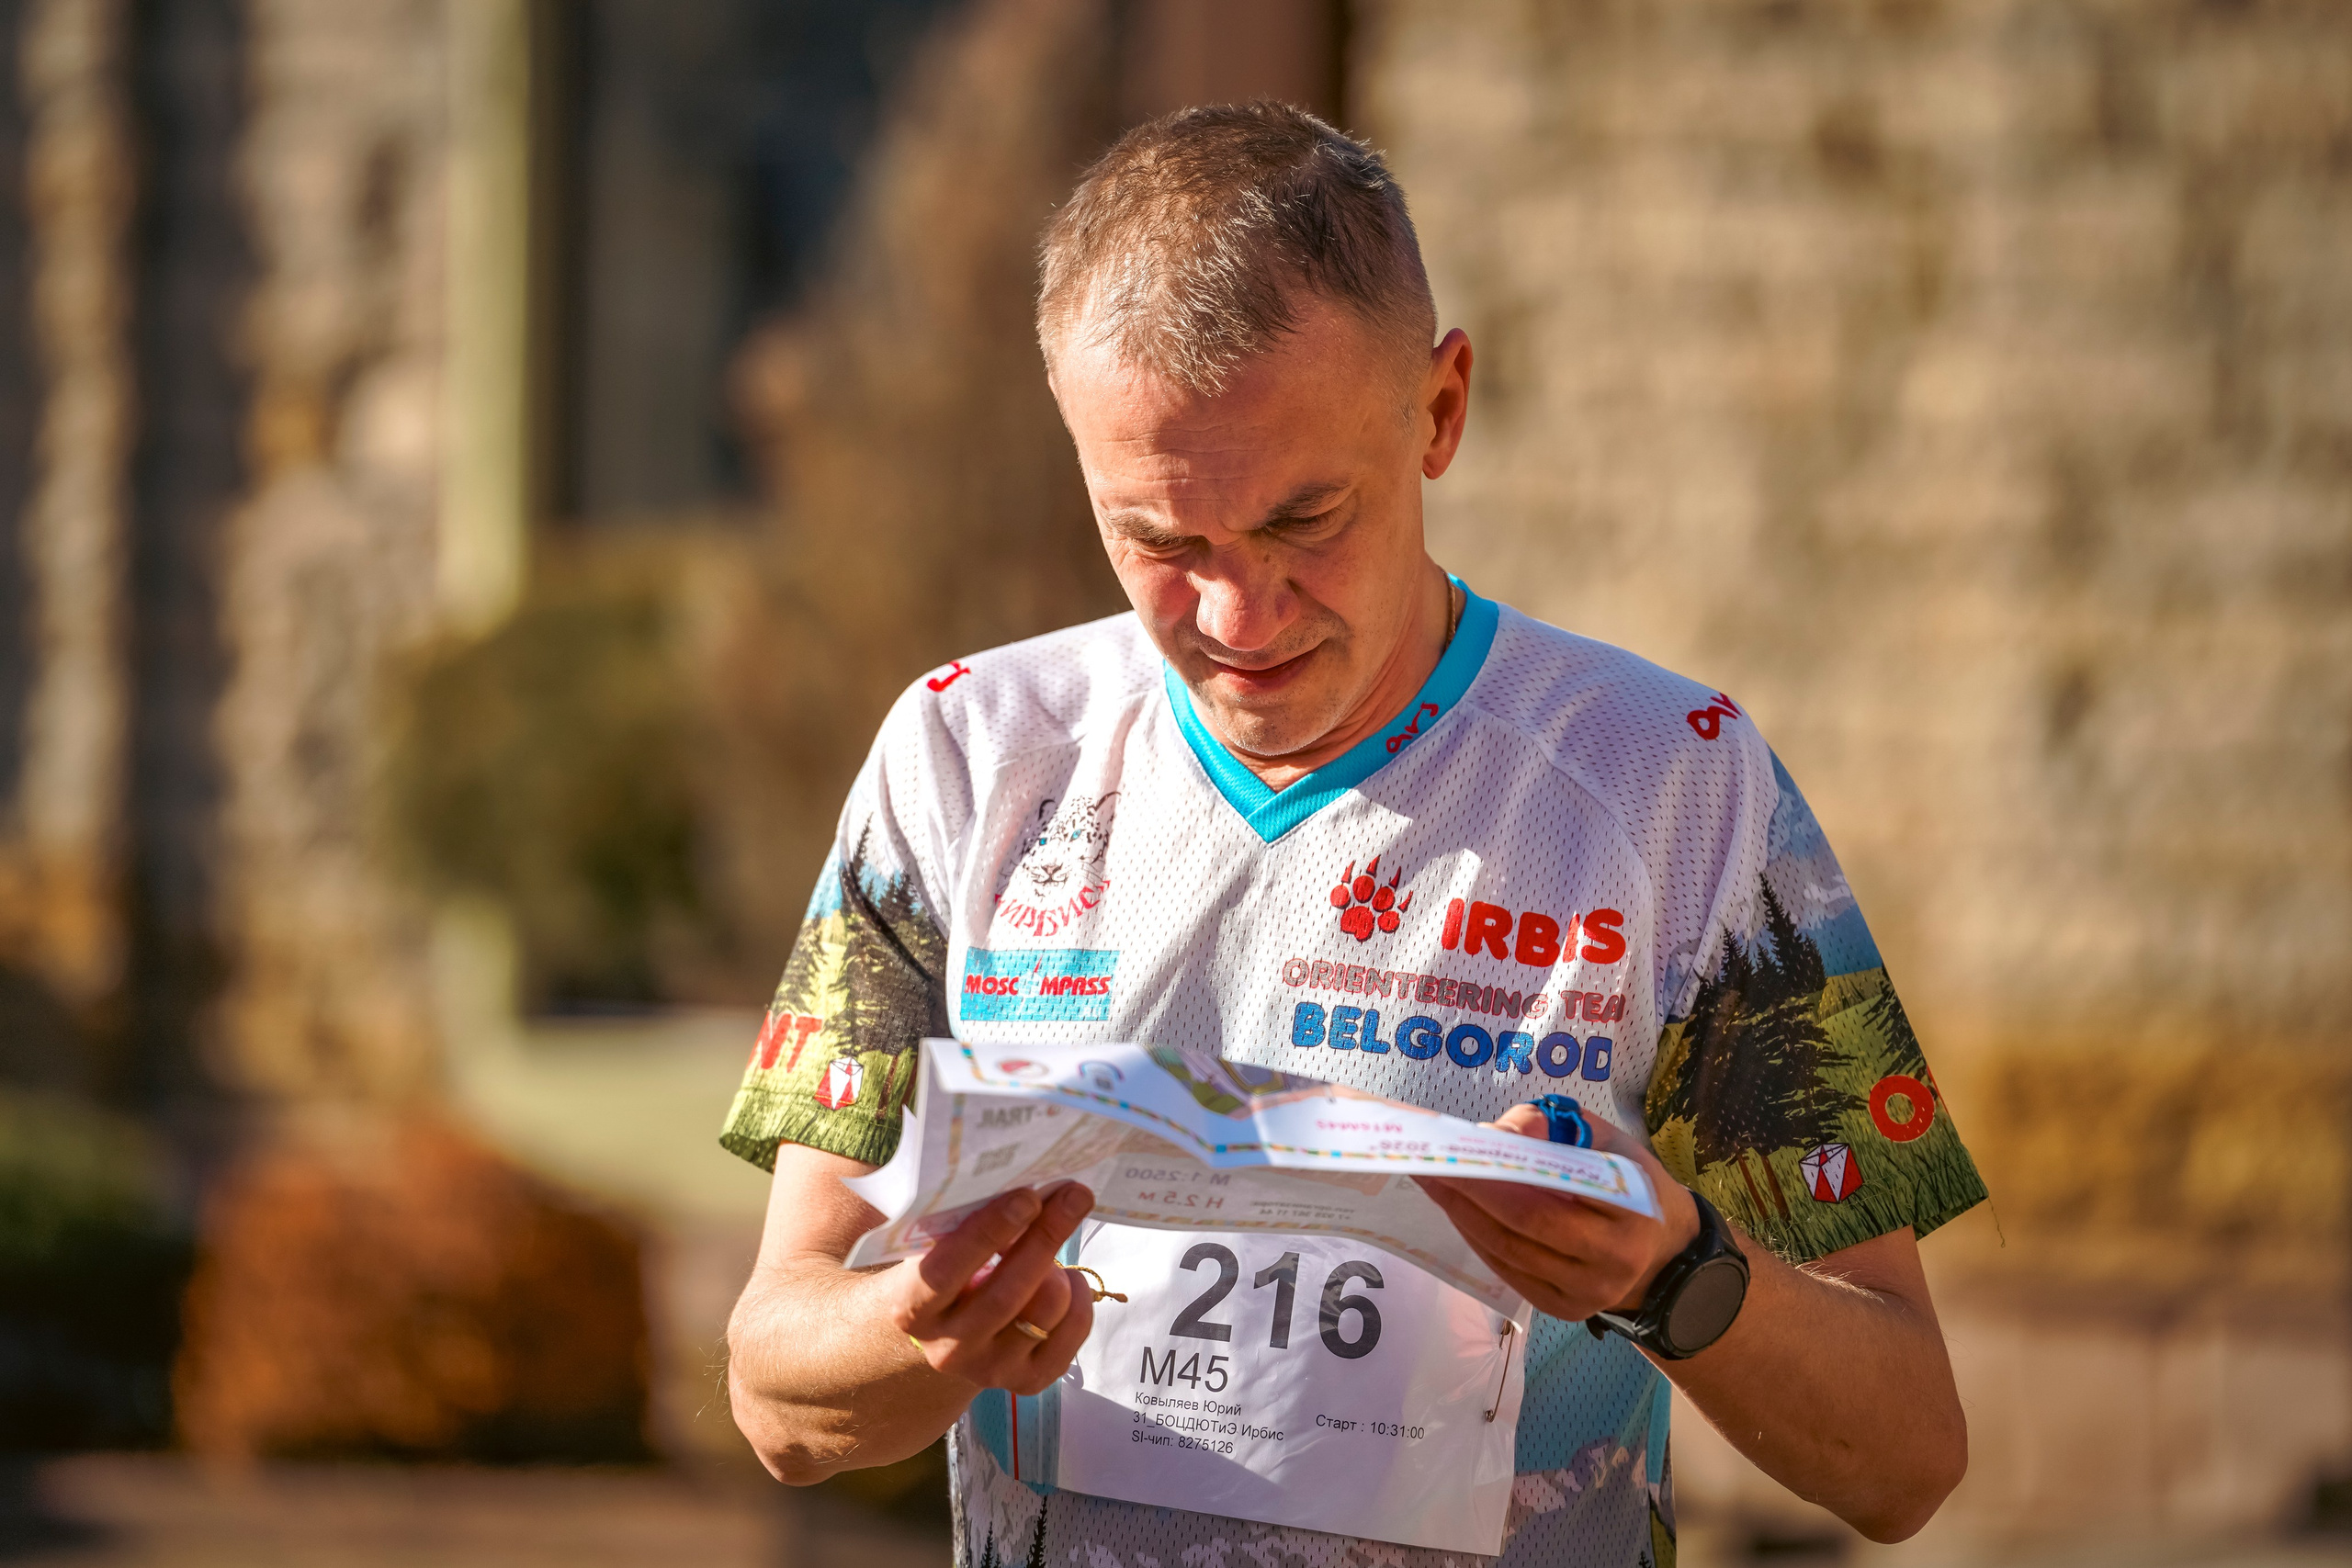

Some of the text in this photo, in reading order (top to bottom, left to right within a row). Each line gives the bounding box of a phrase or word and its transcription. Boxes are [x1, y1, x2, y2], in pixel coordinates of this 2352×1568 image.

[1441, 897, 1627, 967] IRBIS
[1283, 957, 1626, 1023] ORIENTEERING TEA
[1291, 1001, 1612, 1082] BELGOROD
[1169, 1242, 1385, 1359] 216
[1139, 1347, 1229, 1393] M45
[1133, 1411, 1284, 1441] 31_БОЦДЮТиЭ Ирбис
[1135, 1392, 1241, 1416] Ковыляев Юрий
[1316, 1414, 1357, 1432] Старт
[1371, 1421, 1425, 1439] 10:31:00
[1131, 1430, 1234, 1454] SI-чип: 8275126
